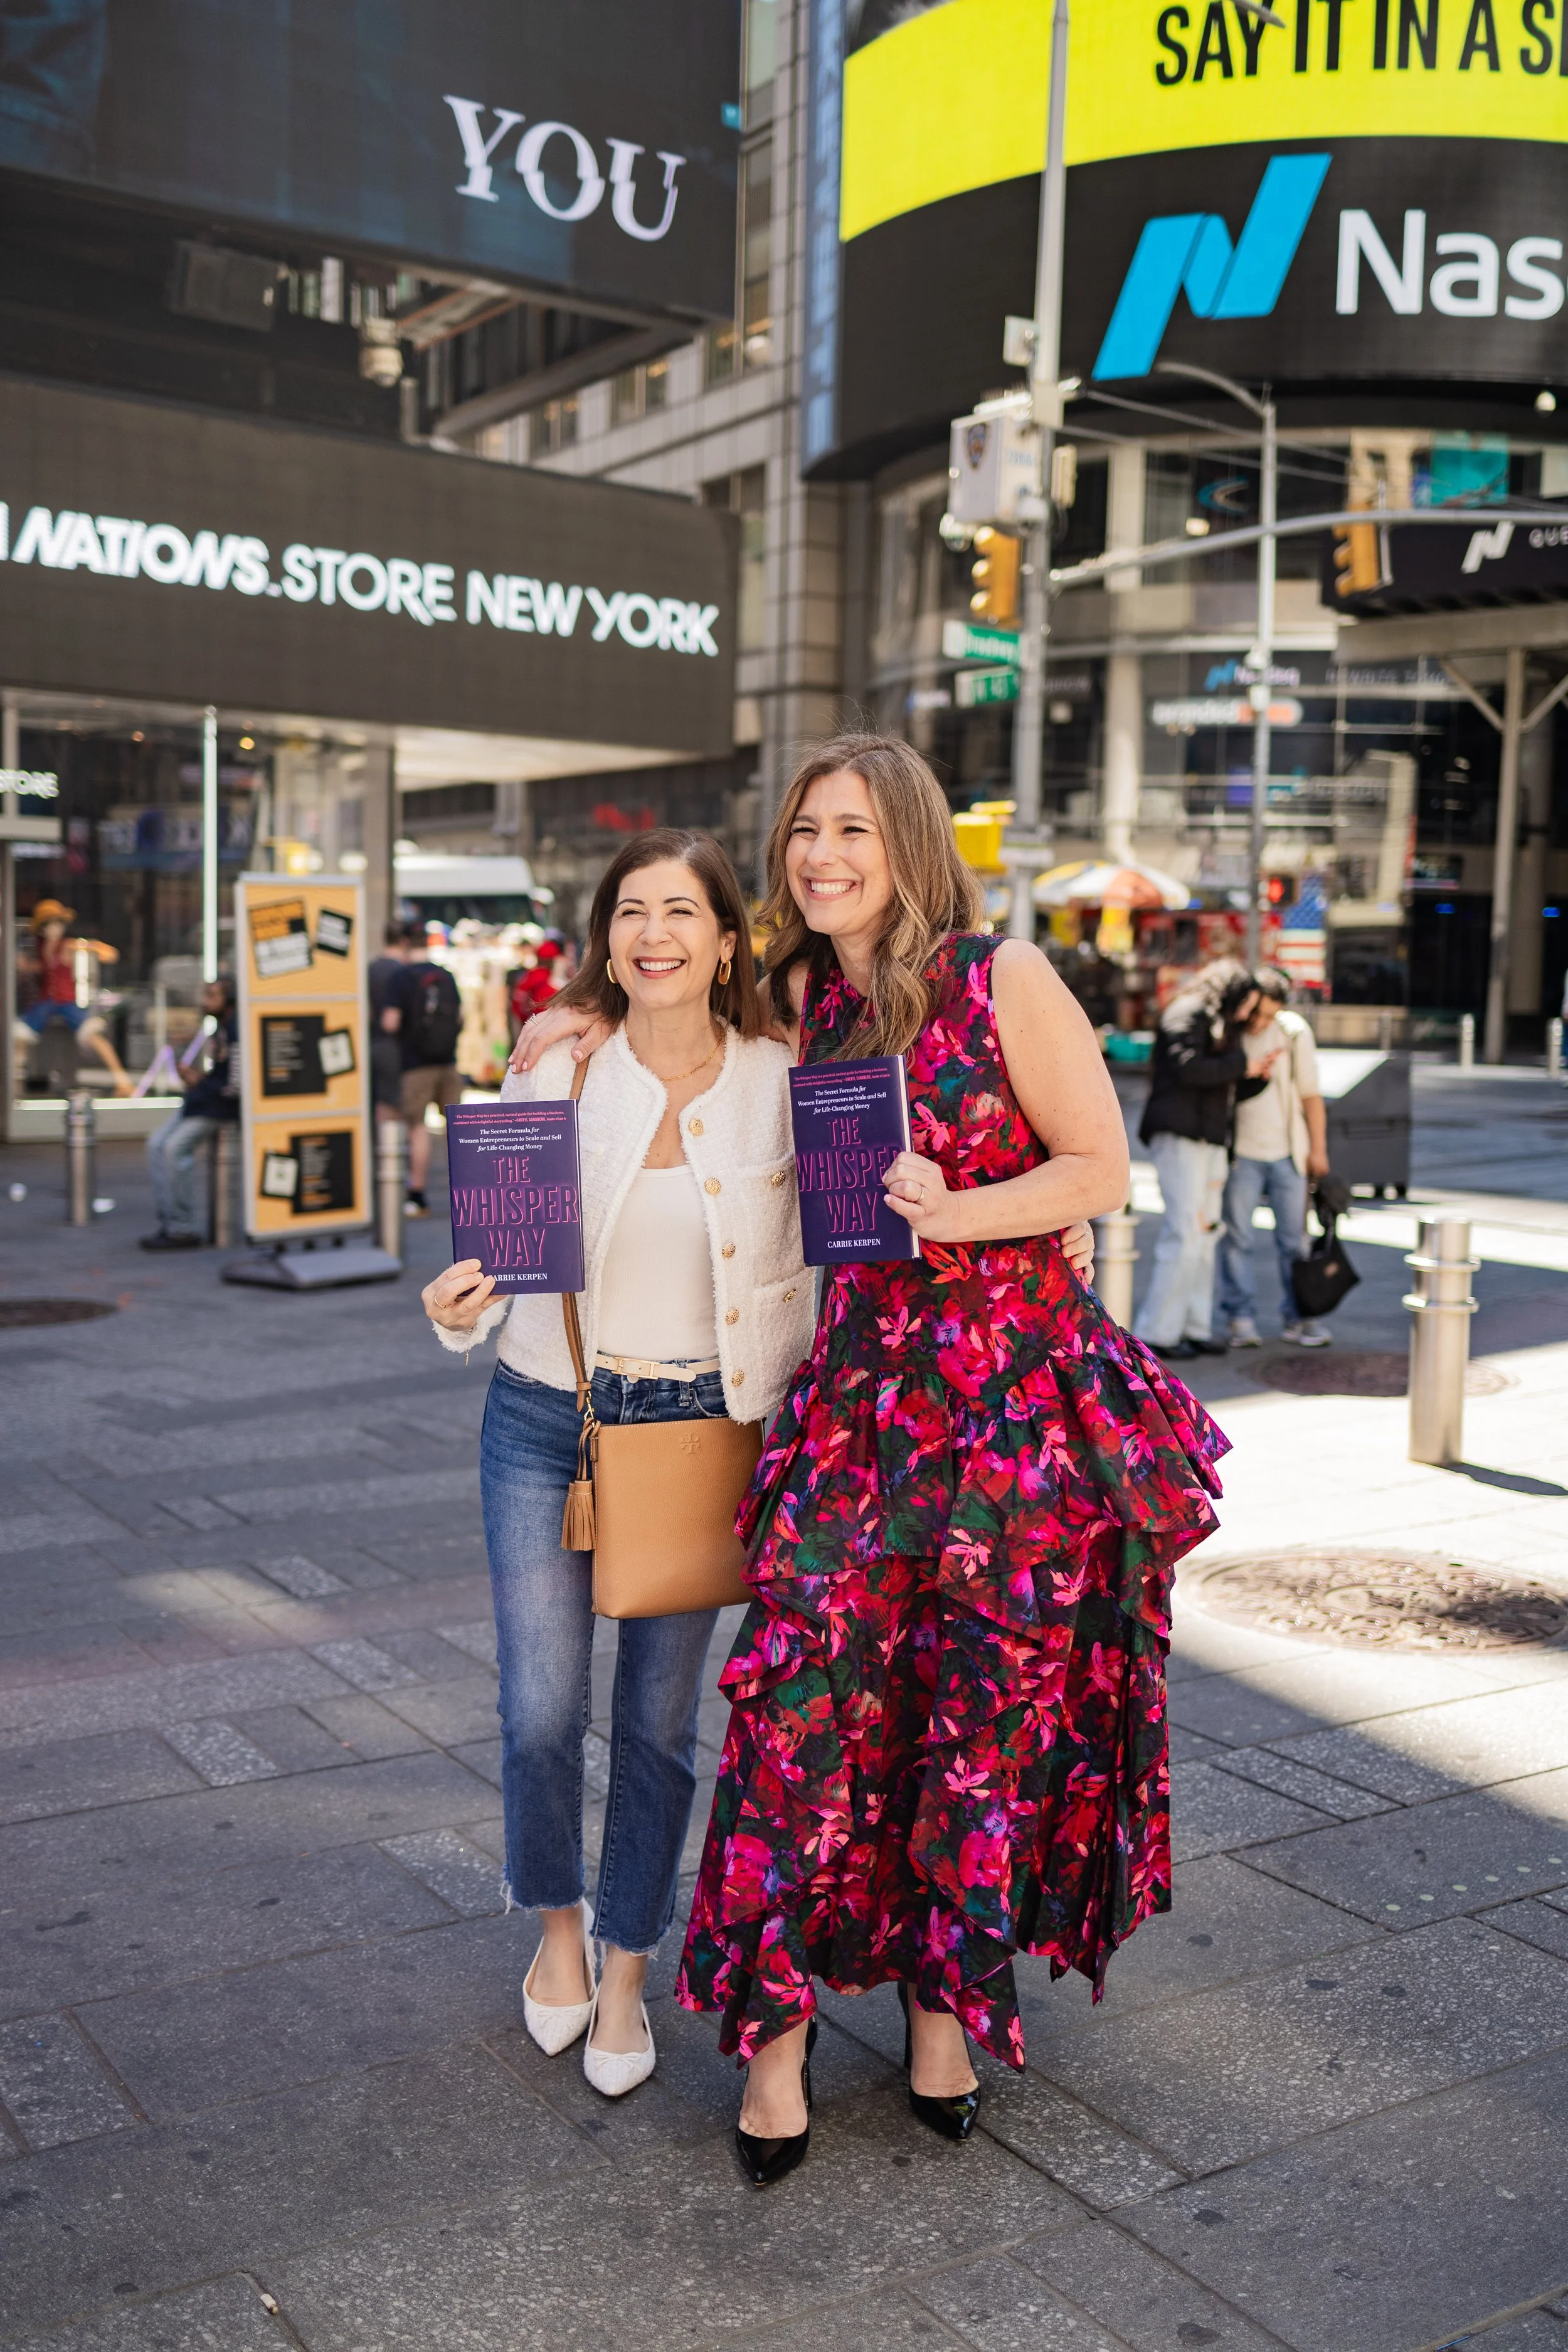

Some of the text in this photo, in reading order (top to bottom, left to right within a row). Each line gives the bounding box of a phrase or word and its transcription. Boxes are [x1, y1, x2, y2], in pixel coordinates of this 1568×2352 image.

[1155, 0, 1274, 86] SAY
[1295, 0, 1356, 72] IT
[1373, 0, 1439, 70] IN
[1458, 0, 1500, 72] A
[442, 94, 687, 241] YOU
[280, 543, 458, 627] STORE
[466, 569, 583, 637] NEW
[585, 586, 719, 657] YORK
[815, 1096, 849, 1104] Entrepreneurs
[822, 1104, 854, 1113] Life-Changing
[827, 1116, 861, 1146] THE
[492, 1156, 531, 1184] THE
[452, 1185, 580, 1226] WHISPER
[825, 1192, 877, 1233] WAY
[485, 1228, 546, 1266] WAY
[827, 1238, 881, 1248] CARRIE KERPEN
[517, 1273, 548, 1281] KERPEN
